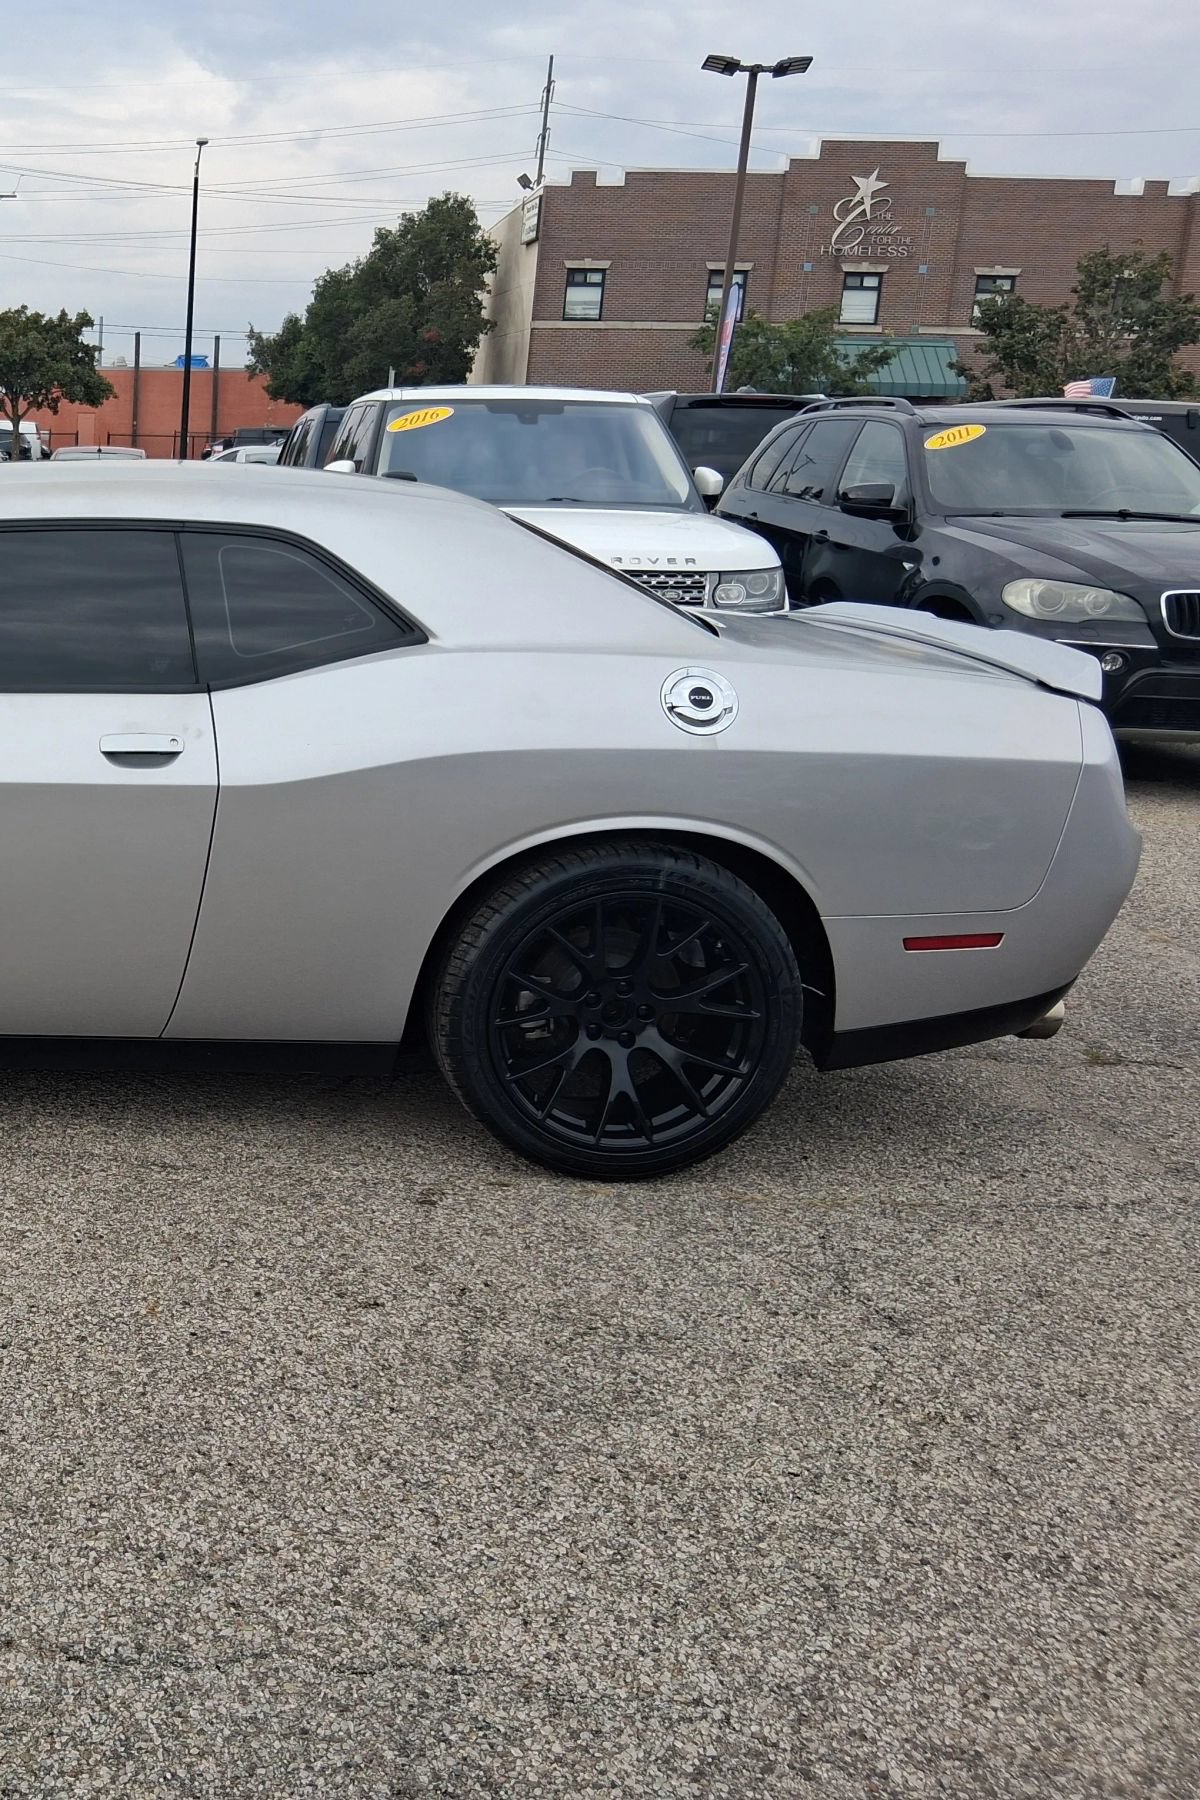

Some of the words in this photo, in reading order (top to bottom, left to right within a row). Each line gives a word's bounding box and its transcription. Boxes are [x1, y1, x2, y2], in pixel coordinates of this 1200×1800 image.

[876, 211, 894, 220] THE
[831, 197, 902, 249] Center
[871, 236, 892, 244] FOR
[896, 236, 914, 244] THE
[820, 245, 908, 257] HOMELESS
[398, 410, 440, 429] 2016
[935, 427, 970, 447] 2011
[610, 556, 697, 566] ROVER
